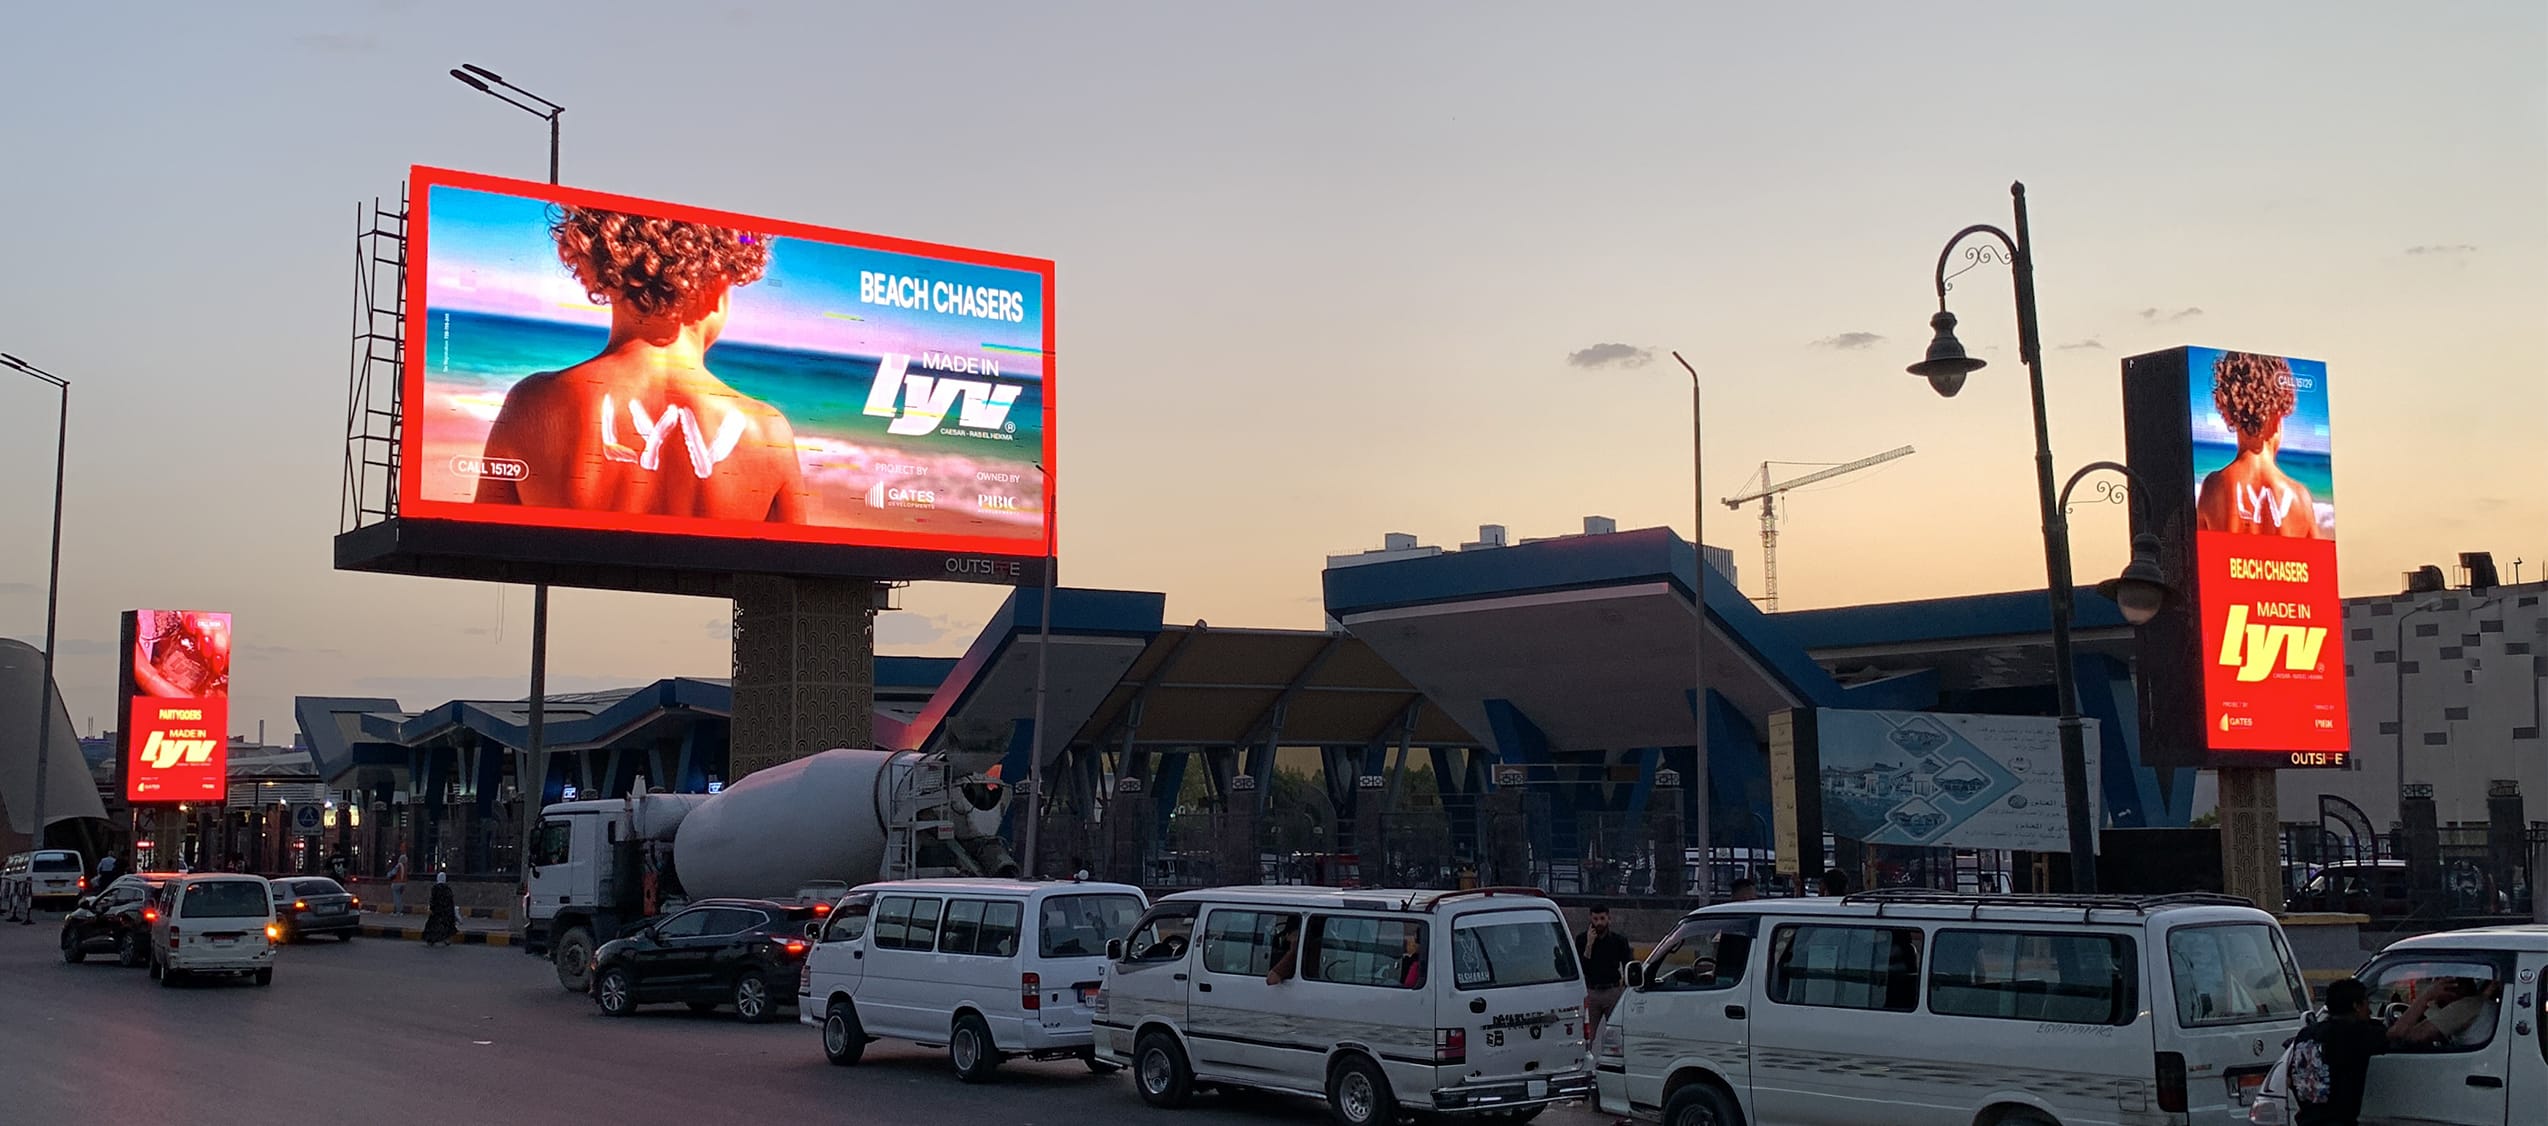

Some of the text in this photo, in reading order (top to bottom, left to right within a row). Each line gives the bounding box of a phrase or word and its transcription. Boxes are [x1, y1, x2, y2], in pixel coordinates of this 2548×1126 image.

[860, 270, 1024, 323] BEACH CHASERS
[922, 352, 1000, 376] MADE IN
[2278, 375, 2296, 387] CALL
[602, 393, 747, 479] LYV
[940, 428, 966, 436] CAESAR
[458, 460, 521, 477] CALL 15129
[875, 463, 928, 476] PROJECT BY
[976, 472, 1020, 484] OWNED BY
[888, 488, 935, 503] GATES
[2237, 481, 2293, 527] LYV
[2230, 558, 2308, 583] BEACH CHASERS
[2257, 601, 2311, 619] MADE IN
[2229, 718, 2252, 727] GATES
[169, 730, 206, 738] MADE IN
